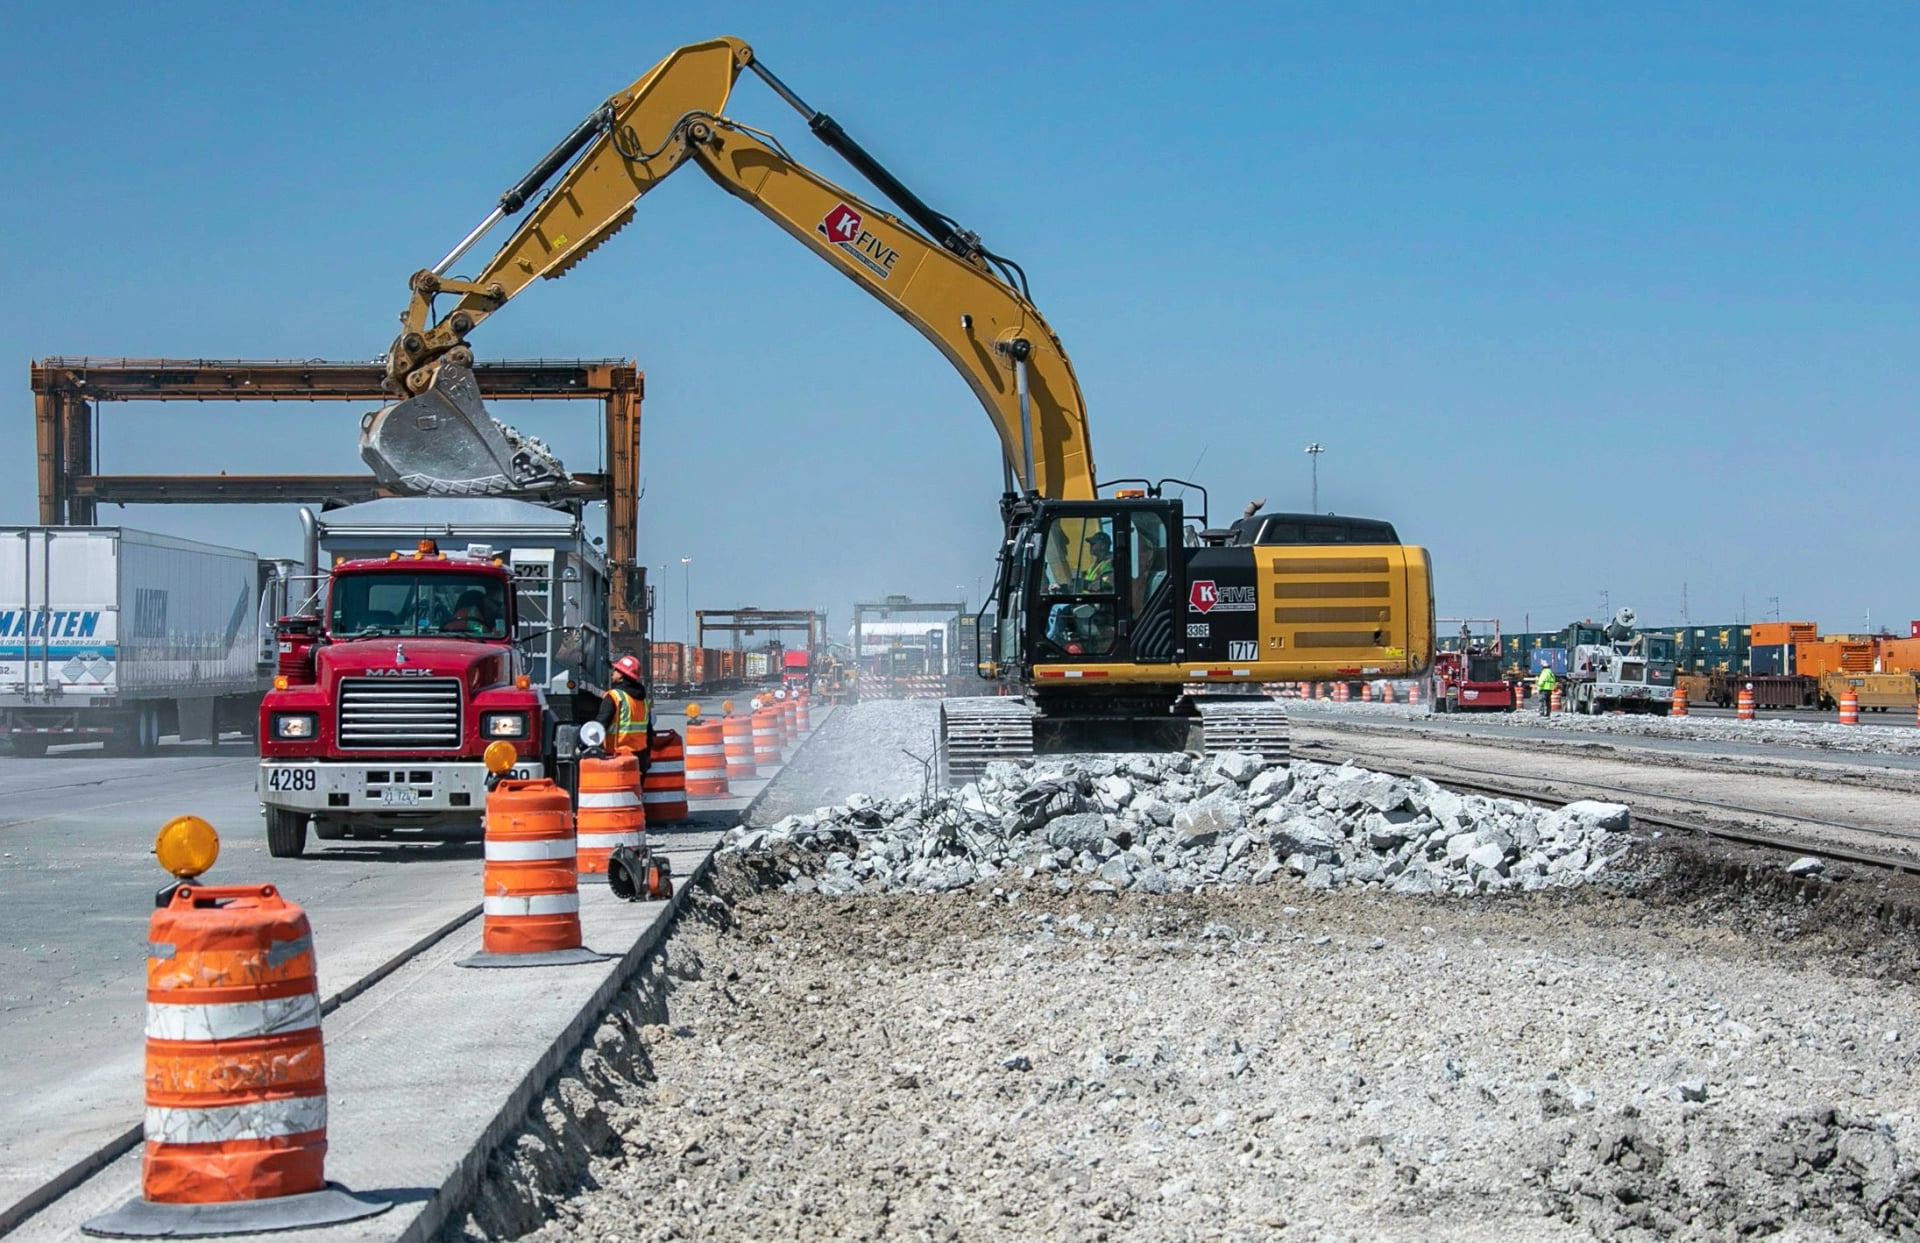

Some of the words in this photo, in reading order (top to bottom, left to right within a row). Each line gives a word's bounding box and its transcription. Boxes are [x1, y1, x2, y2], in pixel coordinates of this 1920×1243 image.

[0, 611, 100, 637] MARTEN
[1230, 641, 1257, 660] 1717
[365, 668, 433, 677] MACK
[269, 769, 316, 791] 4289
